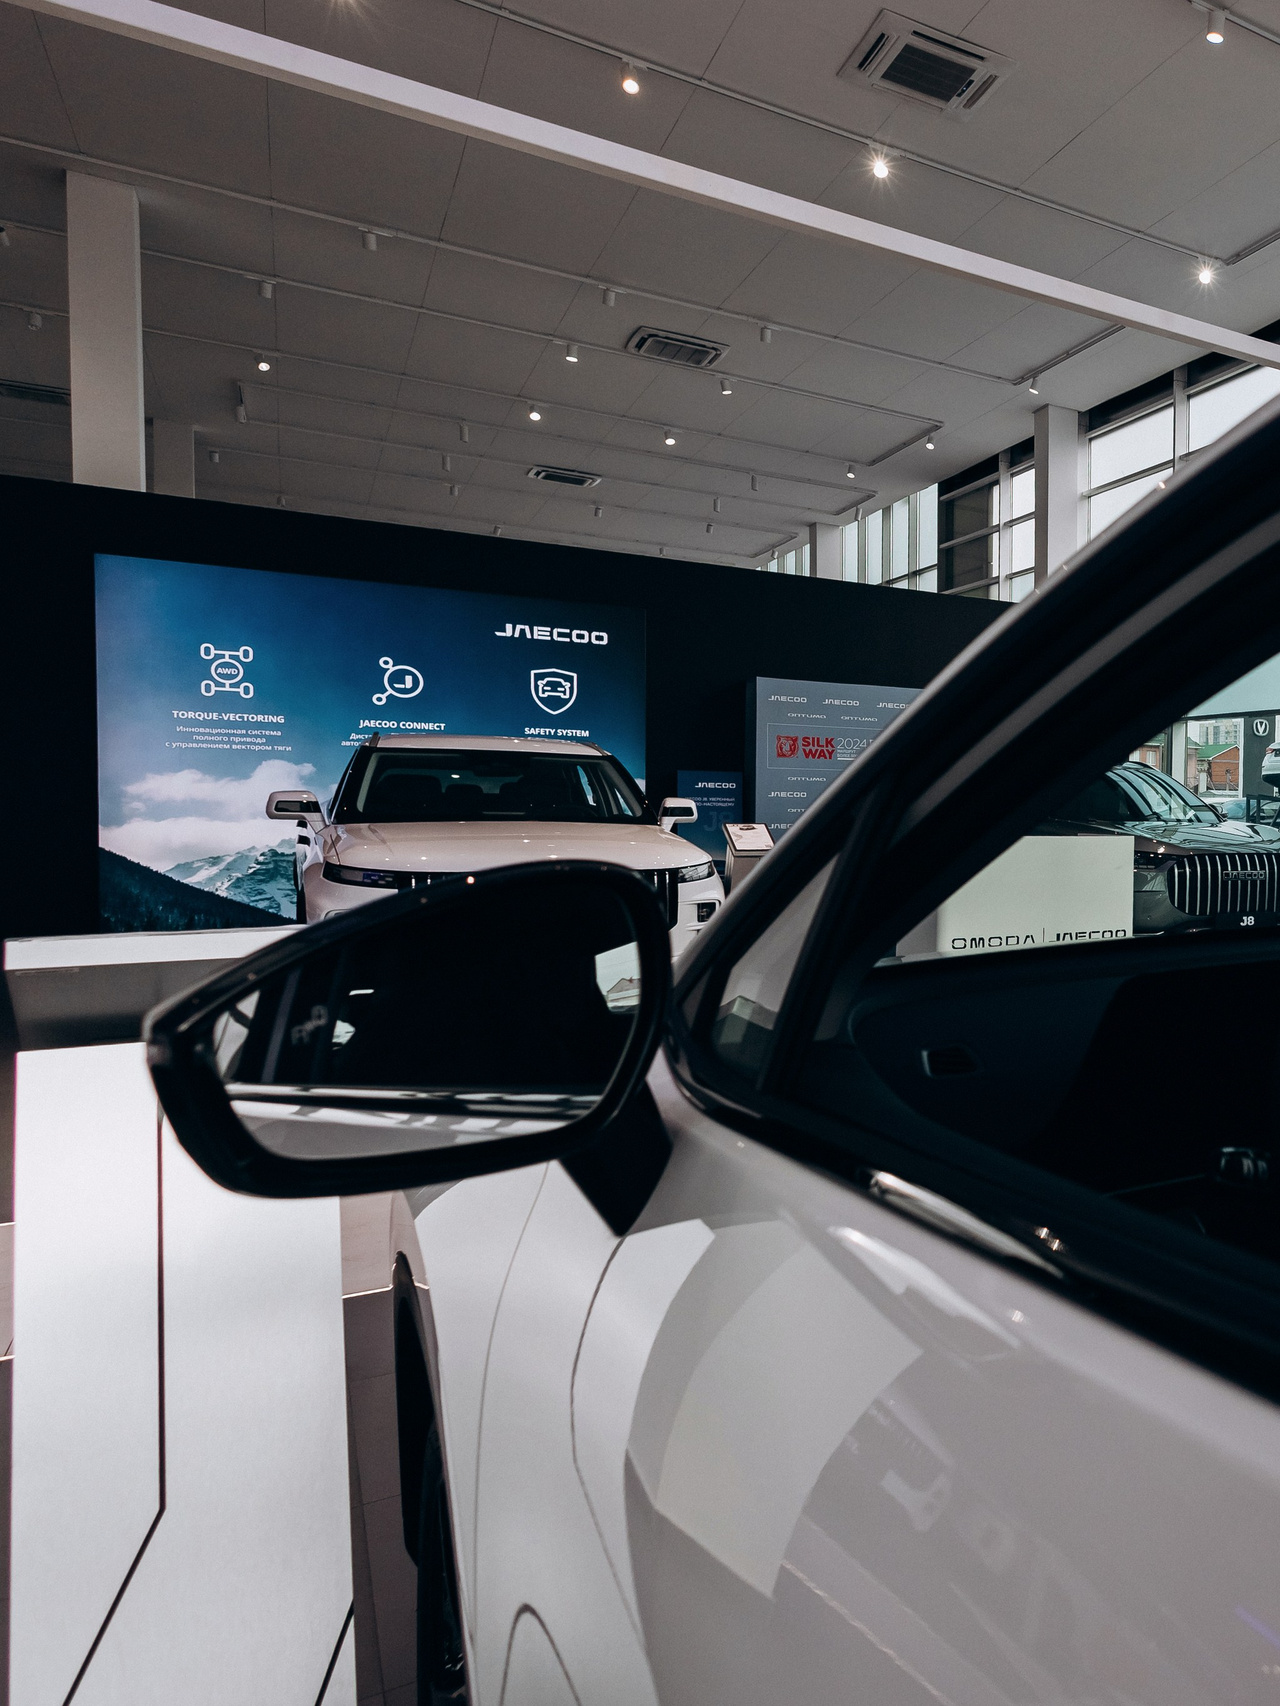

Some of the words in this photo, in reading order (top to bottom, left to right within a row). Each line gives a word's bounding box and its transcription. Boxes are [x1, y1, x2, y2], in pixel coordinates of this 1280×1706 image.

[495, 623, 608, 645] JAECOO
[216, 667, 238, 675] AWD
[768, 695, 807, 703] JAECOO
[822, 698, 860, 706] JAECOO
[172, 710, 285, 723] TORQUE-VECTORING
[176, 725, 246, 736] Инновационная
[359, 719, 398, 729] JAECOO
[399, 720, 446, 731] CONNECT
[524, 727, 556, 736] SAFETY
[556, 729, 590, 737] SYSTEM
[193, 734, 229, 742] полного
[230, 735, 266, 744] привода
[801, 736, 836, 748] SILK
[836, 737, 867, 750] 2024
[172, 741, 230, 750] управлением
[232, 744, 272, 752] вектором
[801, 748, 836, 760] WAY
[1224, 871, 1265, 880] JAECOO
[1240, 915, 1255, 926] J8
[951, 934, 1036, 950] OMODA
[1048, 929, 1127, 943] JAECOO
